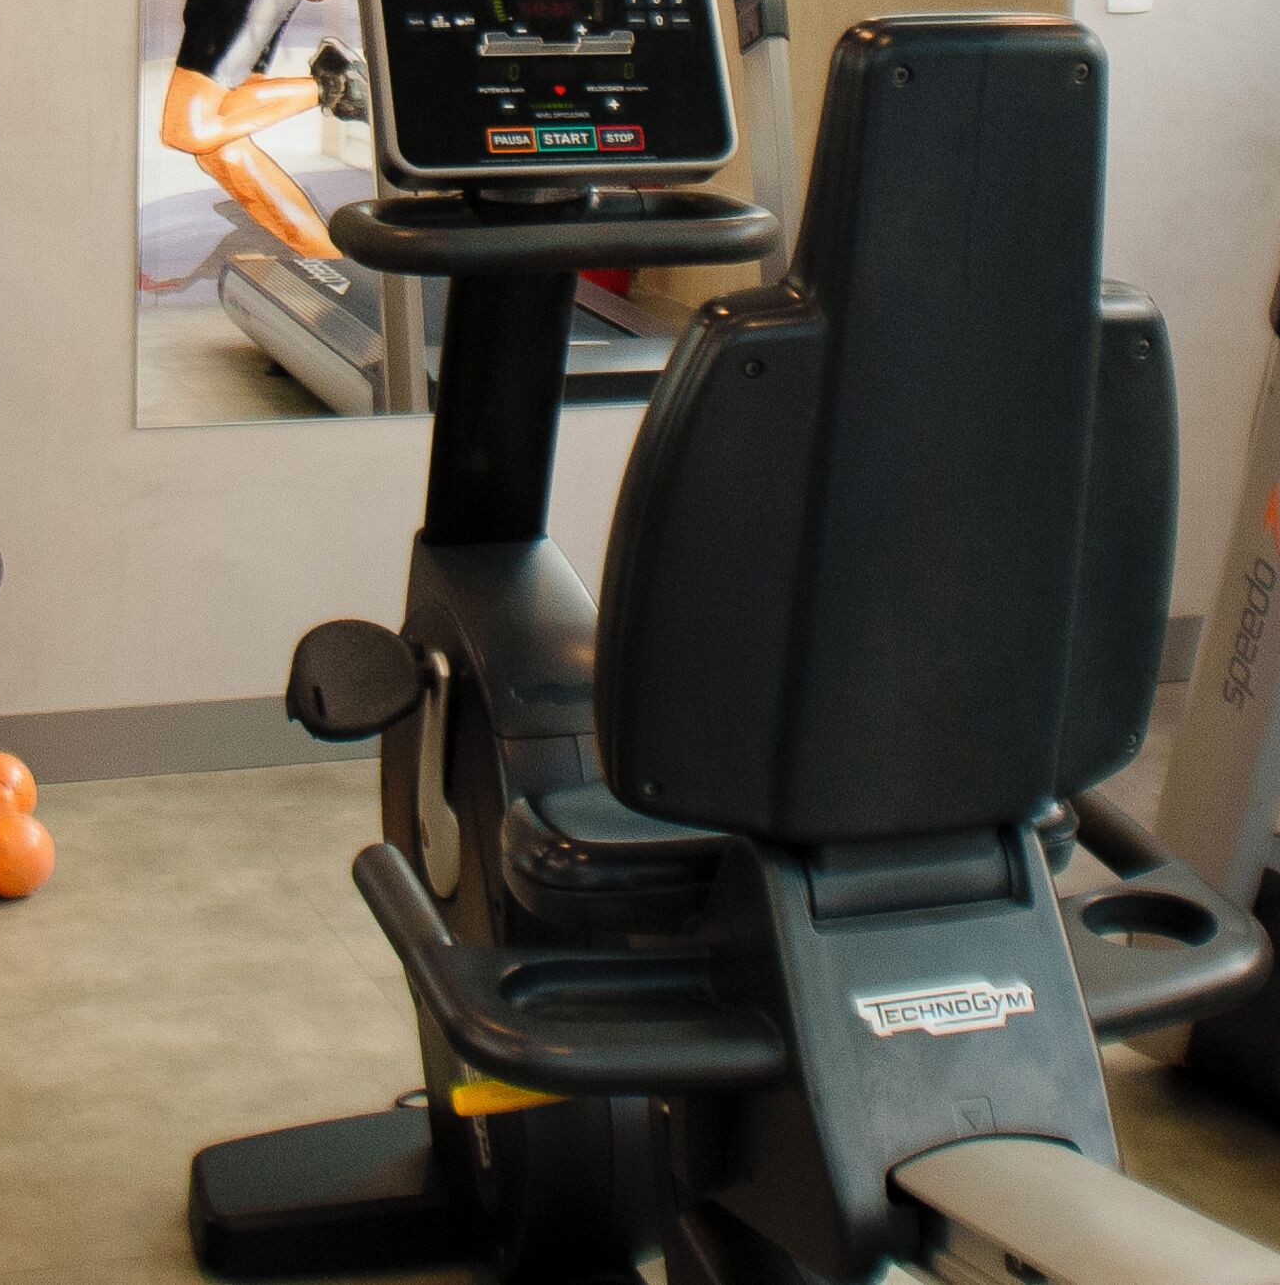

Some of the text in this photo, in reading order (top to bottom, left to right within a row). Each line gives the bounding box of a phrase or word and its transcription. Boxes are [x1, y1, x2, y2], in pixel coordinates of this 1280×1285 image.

[655, 15, 664, 26] 0
[493, 134, 532, 145] PAUSA
[543, 133, 589, 145] START
[605, 133, 635, 143] STOP
[1222, 557, 1277, 710] speedo
